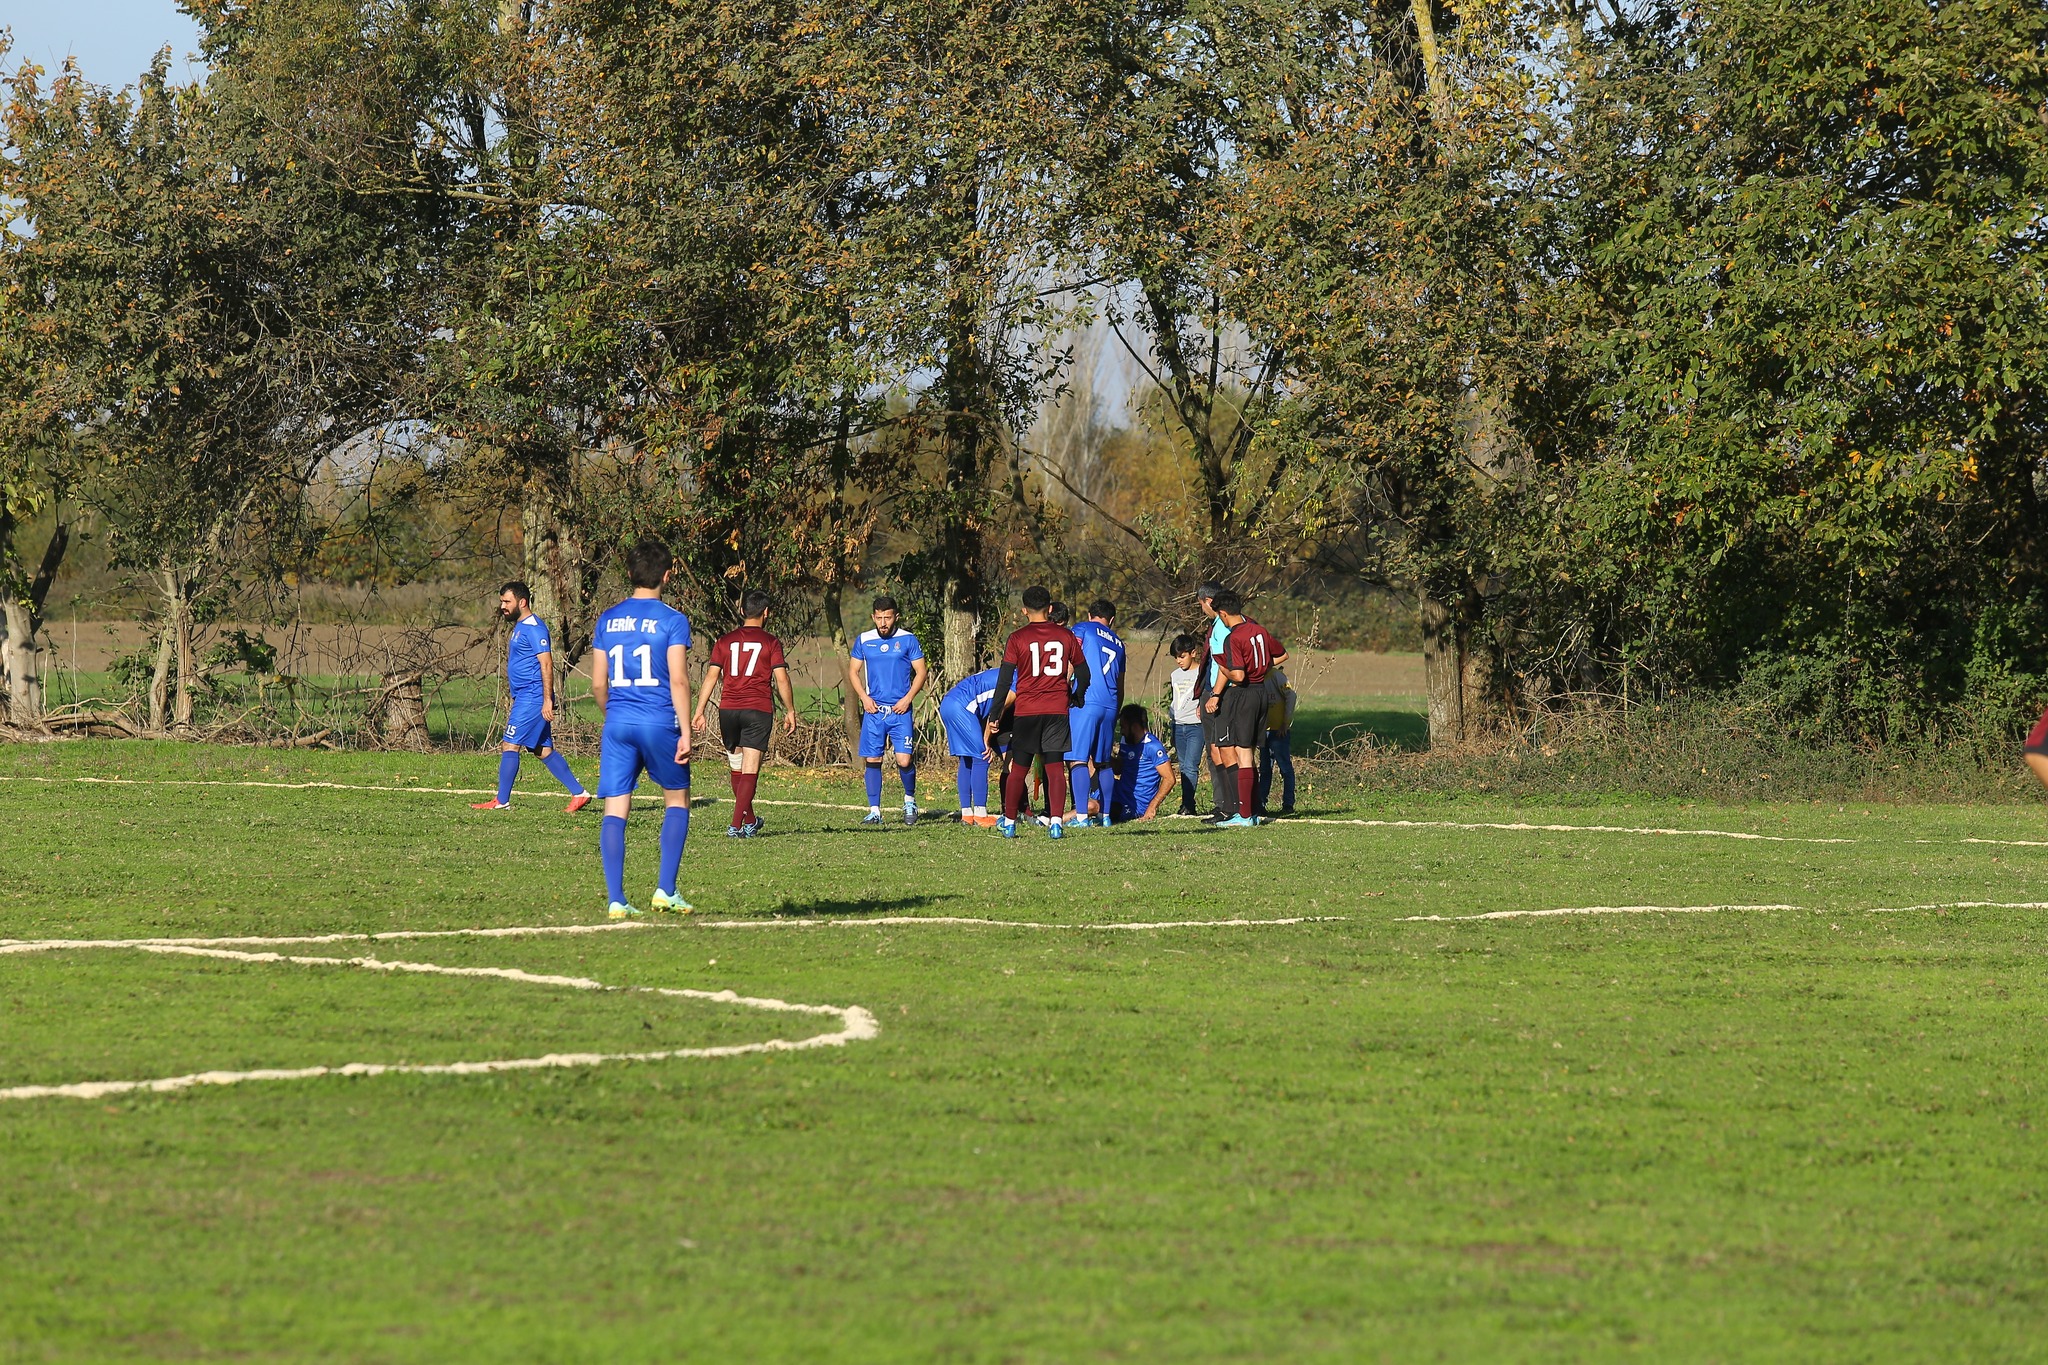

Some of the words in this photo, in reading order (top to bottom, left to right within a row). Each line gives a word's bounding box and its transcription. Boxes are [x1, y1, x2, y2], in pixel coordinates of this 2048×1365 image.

[606, 615, 637, 633] LERİK
[641, 618, 658, 634] FK
[609, 644, 660, 688] 11
[730, 642, 763, 676] 17
[1029, 641, 1064, 677] 13
[1101, 646, 1117, 675] 7
[1250, 633, 1266, 669] 11
[506, 724, 517, 736] 15
